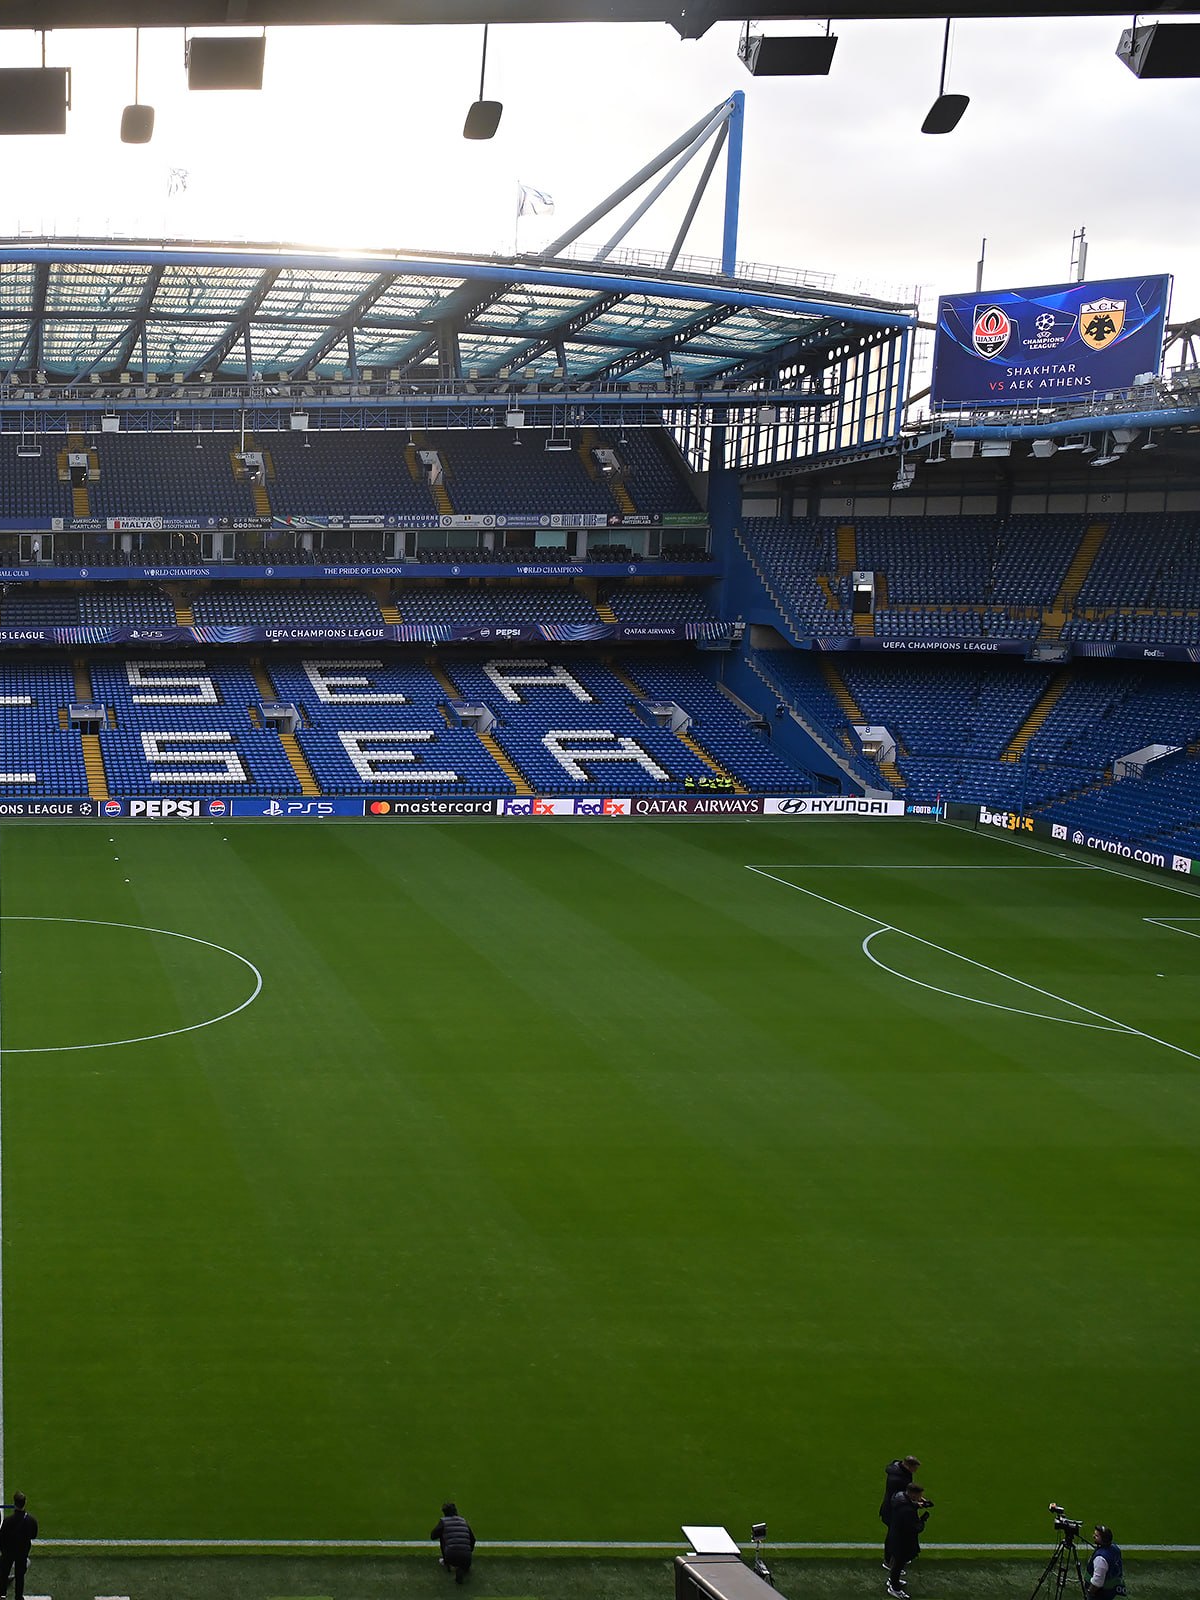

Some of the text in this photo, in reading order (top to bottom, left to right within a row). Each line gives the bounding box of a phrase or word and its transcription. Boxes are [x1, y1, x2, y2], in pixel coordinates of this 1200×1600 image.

[1022, 336, 1065, 346] CHAMPIONS
[1006, 364, 1076, 378] SHAKHTAR
[988, 376, 1092, 391] VS AEK ATHENS
[846, 498, 852, 506] 8
[170, 568, 210, 576] CHAMPIONS
[9, 631, 45, 640] LEAGUE
[265, 629, 384, 638] UEFA CHAMPIONS LEAGUE
[495, 628, 521, 636] PEPSI
[882, 641, 999, 651] UEFA CHAMPIONS LEAGUE
[865, 726, 871, 734] 8
[28, 804, 73, 815] LEAGUE
[130, 800, 200, 817] PEPSI
[288, 802, 333, 814] PS5
[394, 800, 492, 813] mastercard
[504, 799, 554, 815] FedEx
[574, 799, 624, 815] FedEx
[636, 800, 759, 816] QATAR AIRWAYS
[811, 800, 888, 814] HYUNDAI
[1087, 836, 1164, 868] crypto.com
